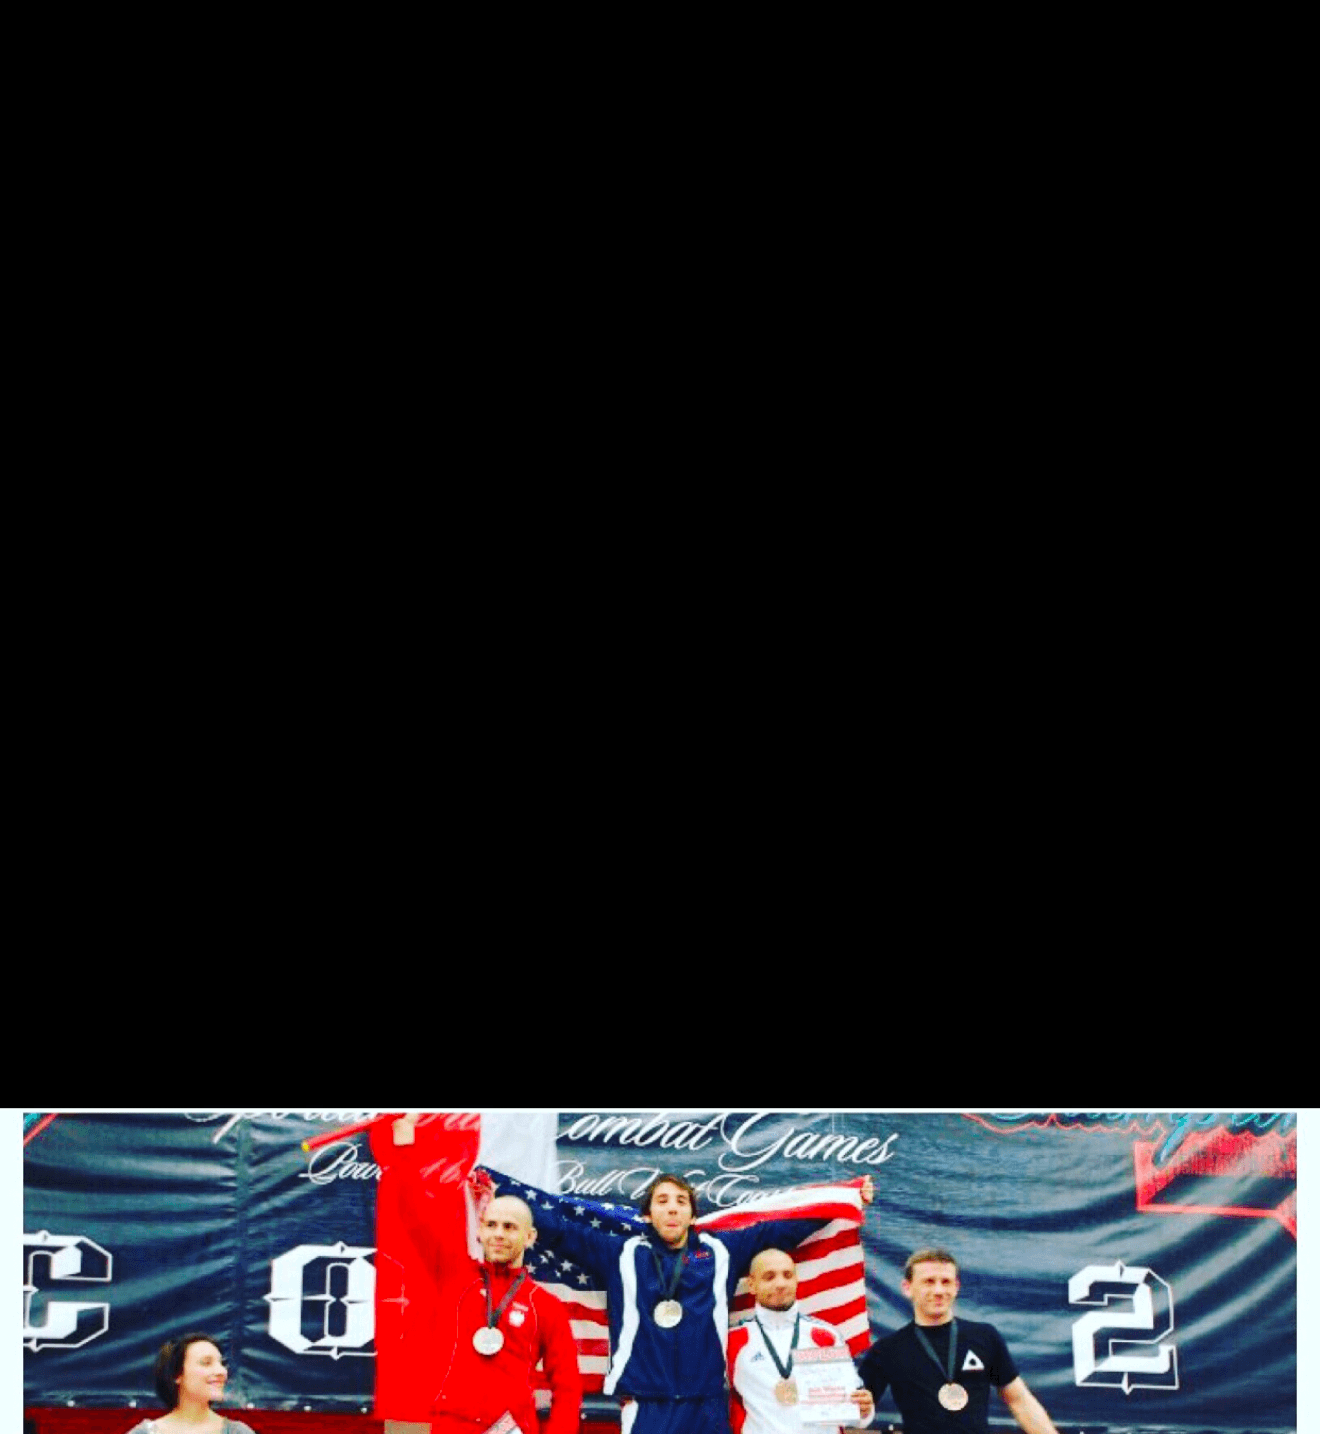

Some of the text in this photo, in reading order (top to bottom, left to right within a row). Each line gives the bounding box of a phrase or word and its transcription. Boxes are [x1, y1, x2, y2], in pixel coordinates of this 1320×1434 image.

[556, 1112, 899, 1172] ombat Games
[1067, 1259, 1180, 1395] 2
